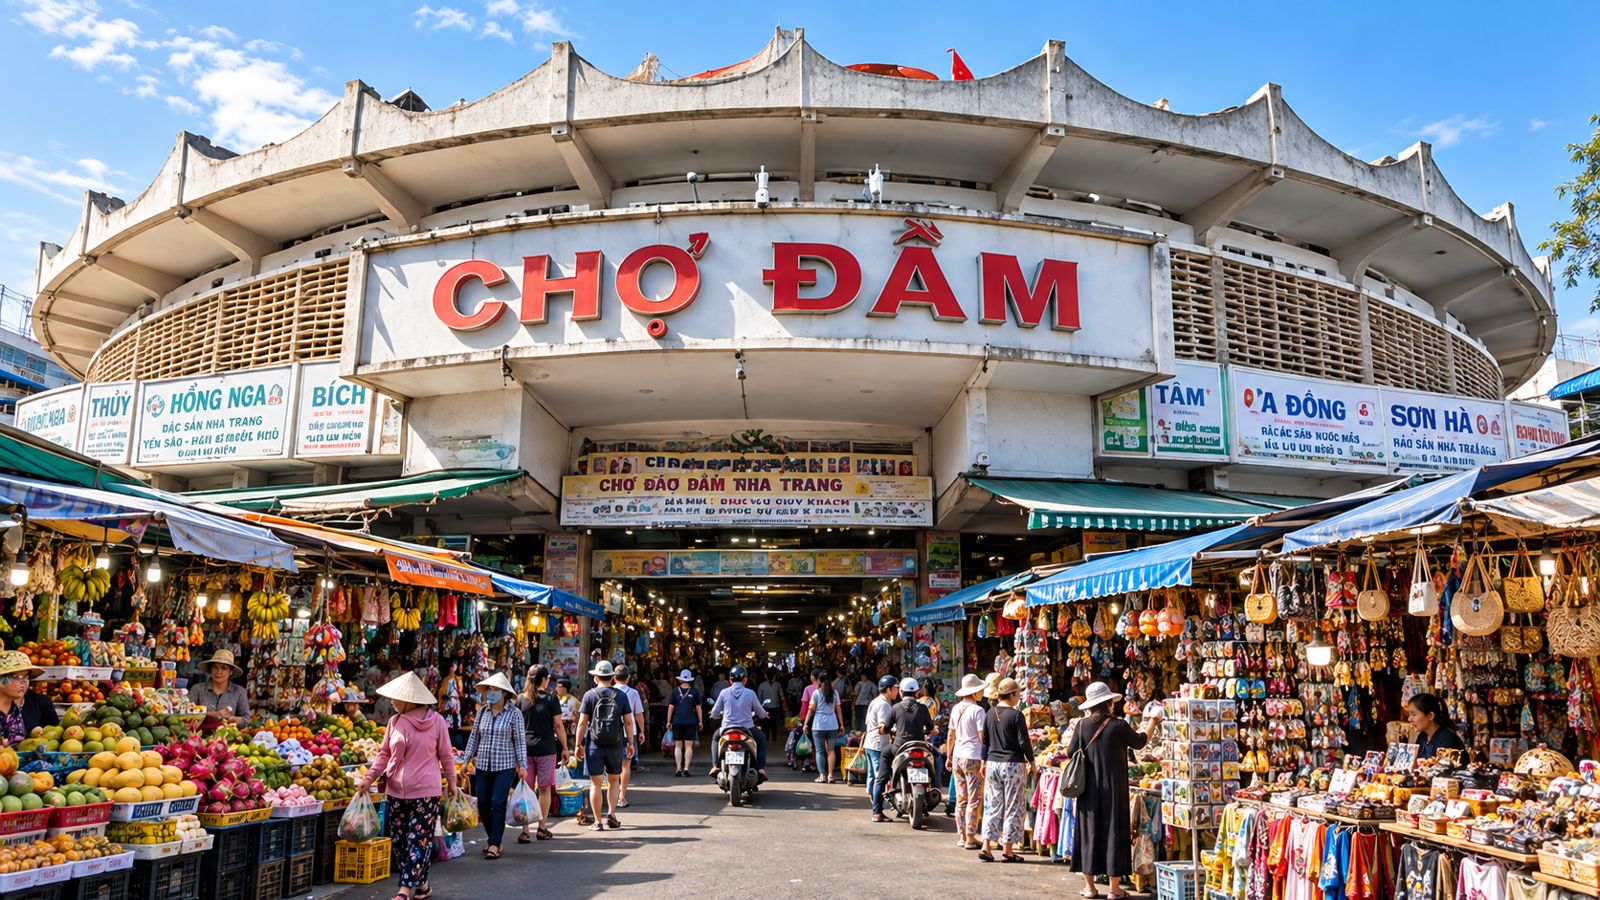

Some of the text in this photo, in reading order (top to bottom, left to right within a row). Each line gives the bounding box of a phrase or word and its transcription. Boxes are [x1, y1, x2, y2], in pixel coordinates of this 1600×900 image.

[432, 217, 1082, 339] CHỢ ĐẦM
[227, 384, 266, 409] NGA
[312, 380, 366, 407] BÍCH
[1155, 381, 1205, 406] TÂM
[206, 419, 225, 430] NHA
[229, 416, 263, 428] TRANG
[1444, 406, 1474, 434] HÀ
[779, 477, 843, 492] TRANG
